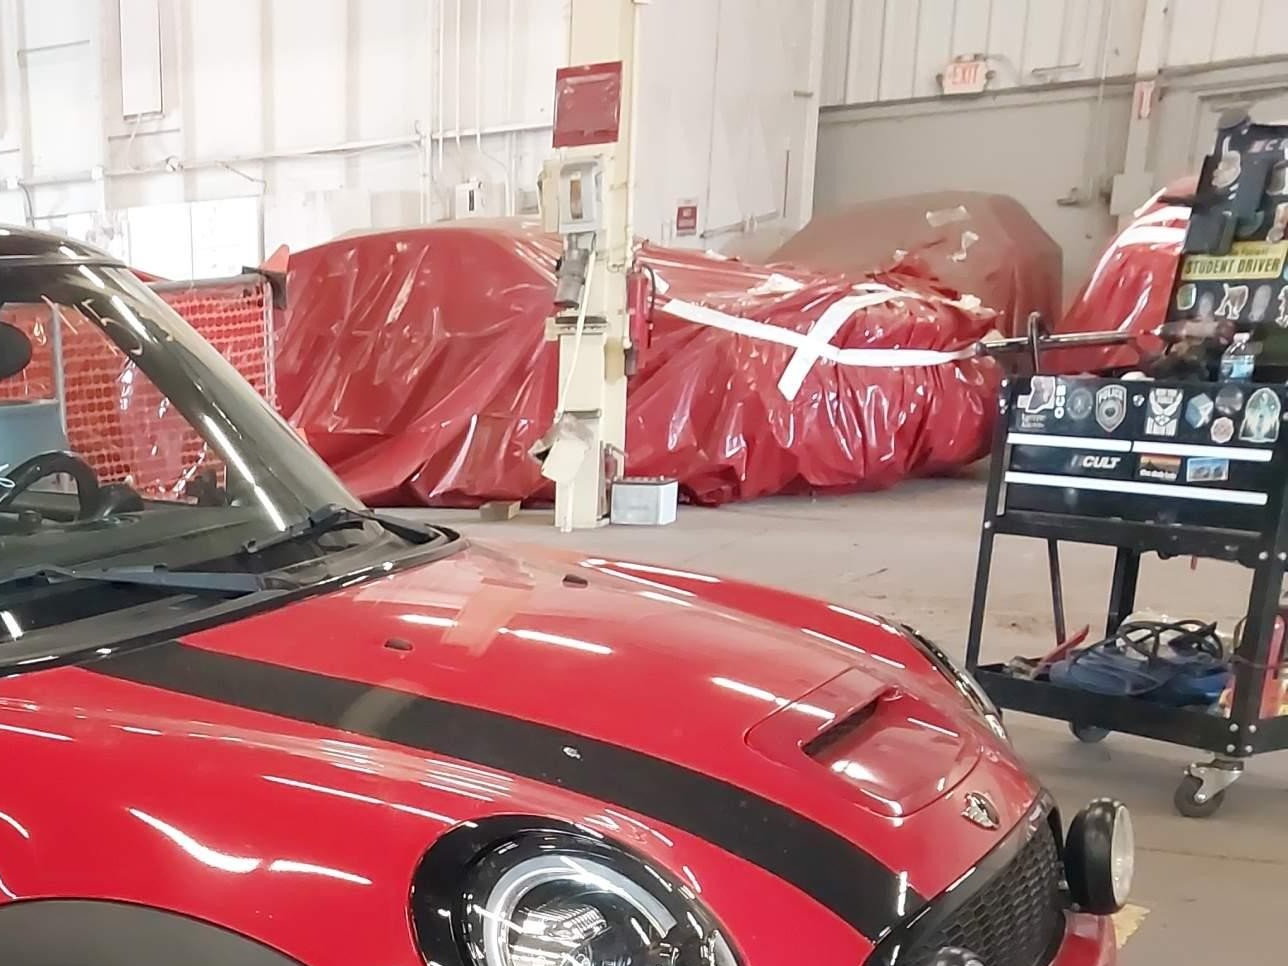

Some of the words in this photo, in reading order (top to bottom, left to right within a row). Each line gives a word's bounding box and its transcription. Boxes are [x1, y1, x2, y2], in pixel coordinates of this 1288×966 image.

[1184, 257, 1234, 275] STUDENT
[1237, 256, 1282, 274] DRIVER
[1082, 455, 1121, 469] CULT
